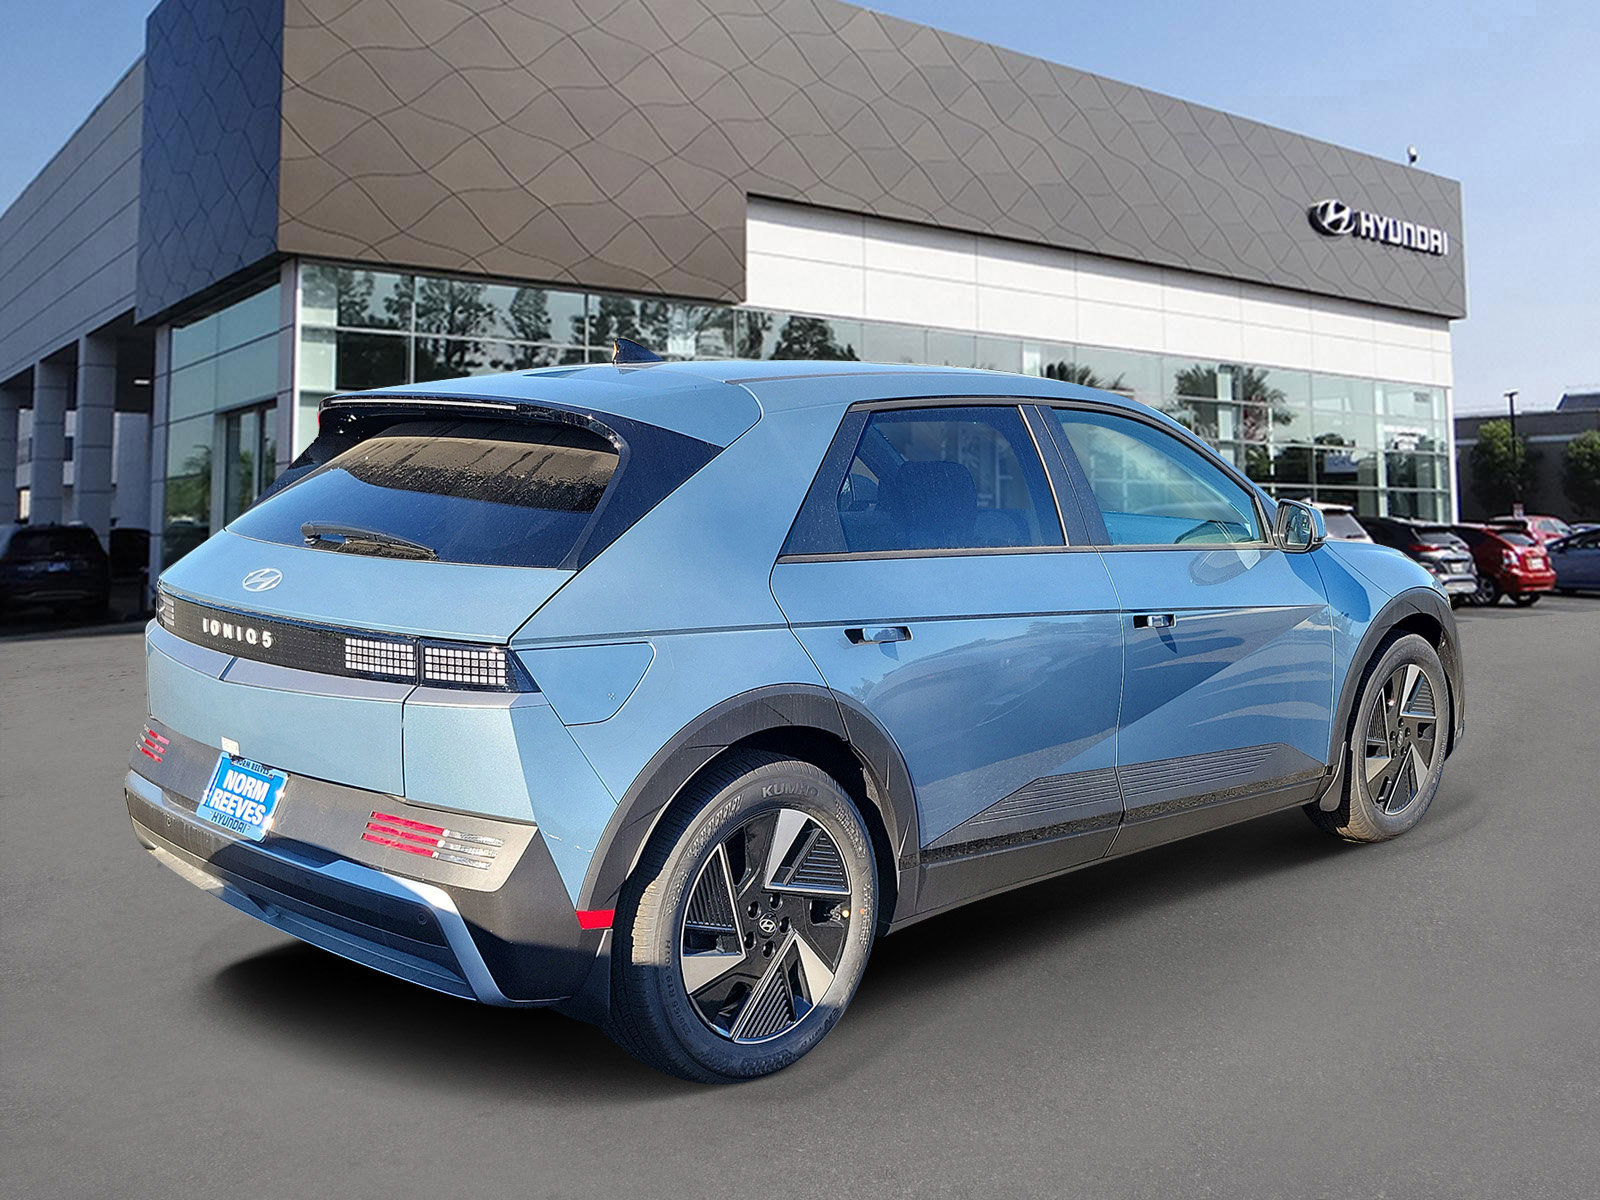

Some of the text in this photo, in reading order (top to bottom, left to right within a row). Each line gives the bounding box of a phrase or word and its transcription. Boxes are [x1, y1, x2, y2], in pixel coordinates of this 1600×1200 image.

[1359, 211, 1449, 256] HYUNDAI
[202, 617, 273, 649] IONIQ 5
[222, 769, 271, 803] NORM
[210, 788, 267, 826] REEVES
[210, 811, 248, 834] HYUNDAI
